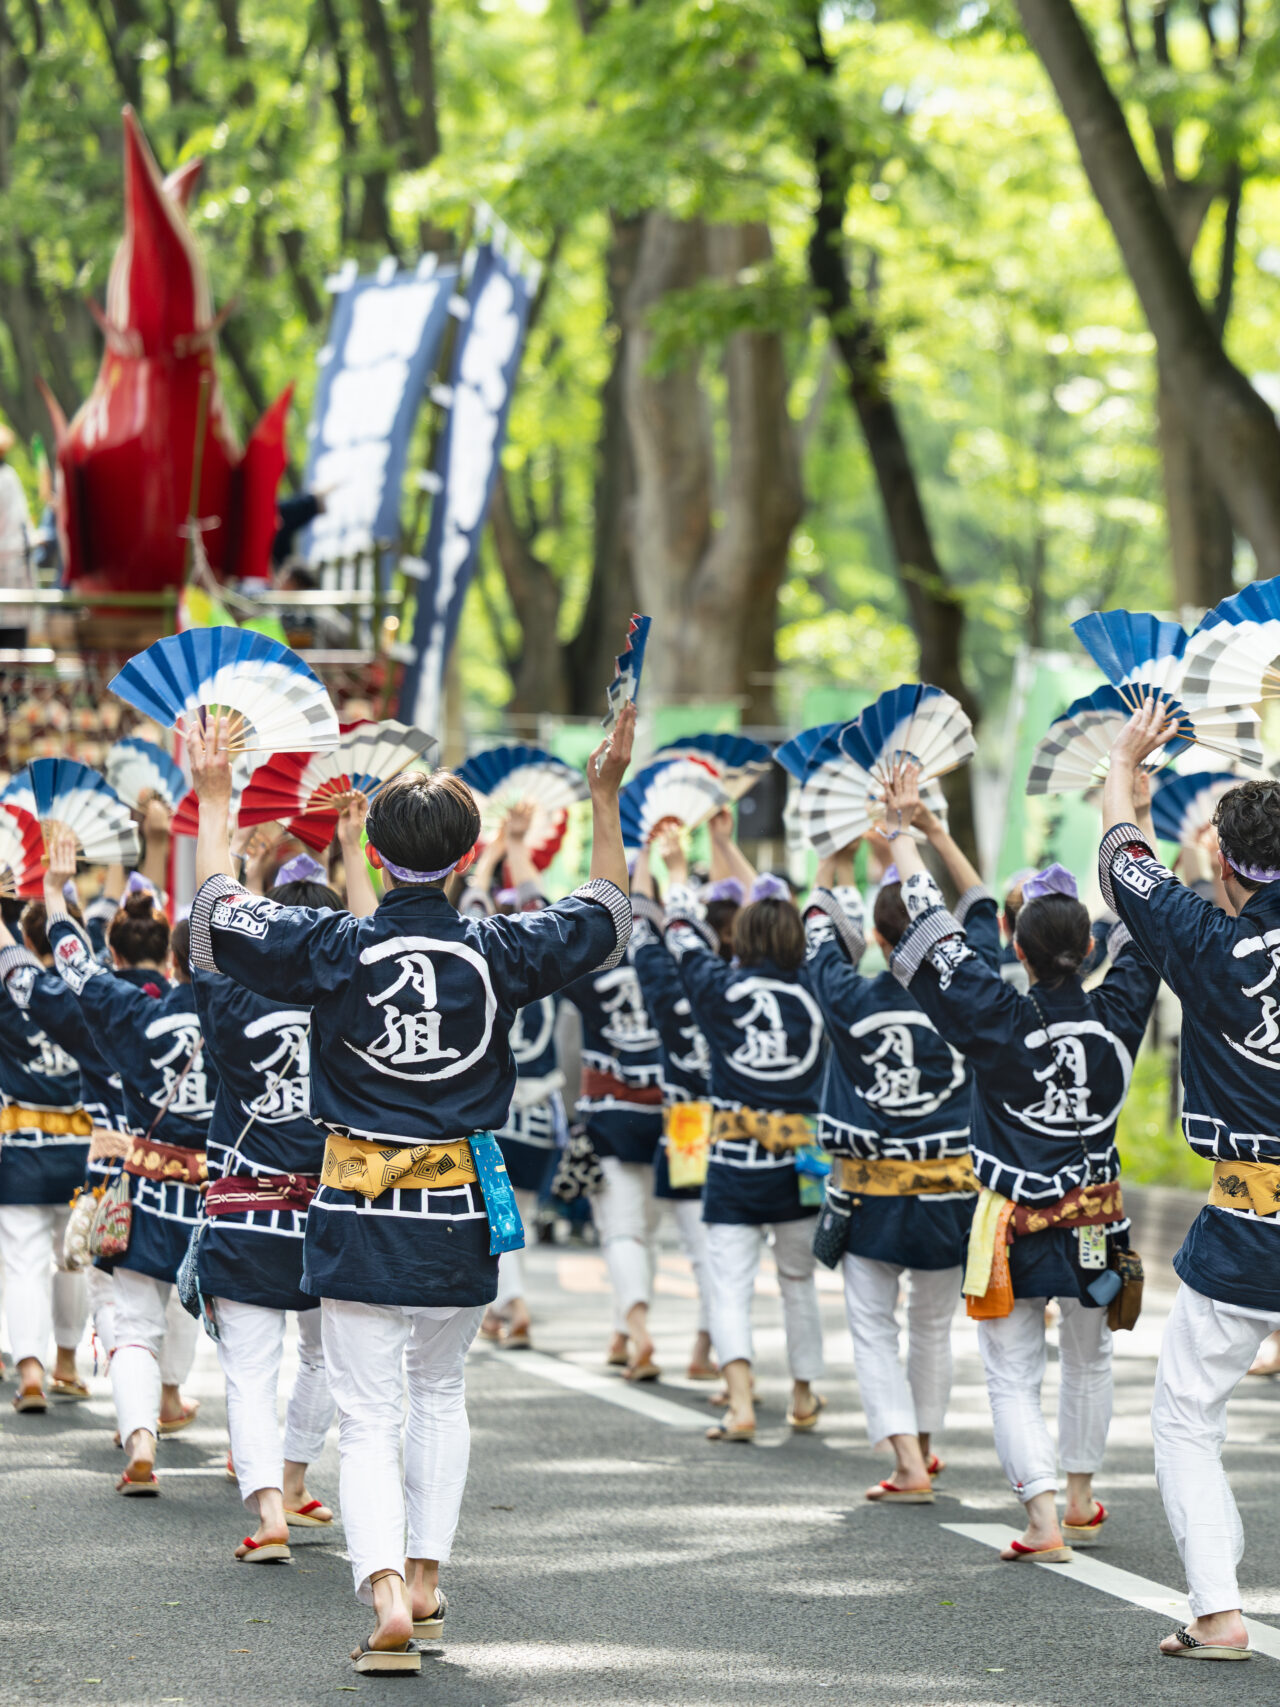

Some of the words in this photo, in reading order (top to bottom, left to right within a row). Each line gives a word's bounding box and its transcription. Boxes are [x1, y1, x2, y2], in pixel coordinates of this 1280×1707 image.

[366, 952, 462, 1065] 月組
[732, 989, 801, 1069] 月組
[149, 1026, 217, 1114] 月組
[249, 1025, 311, 1118] 月組
[860, 1024, 936, 1107] 月組
[1023, 1035, 1103, 1124] 月組
